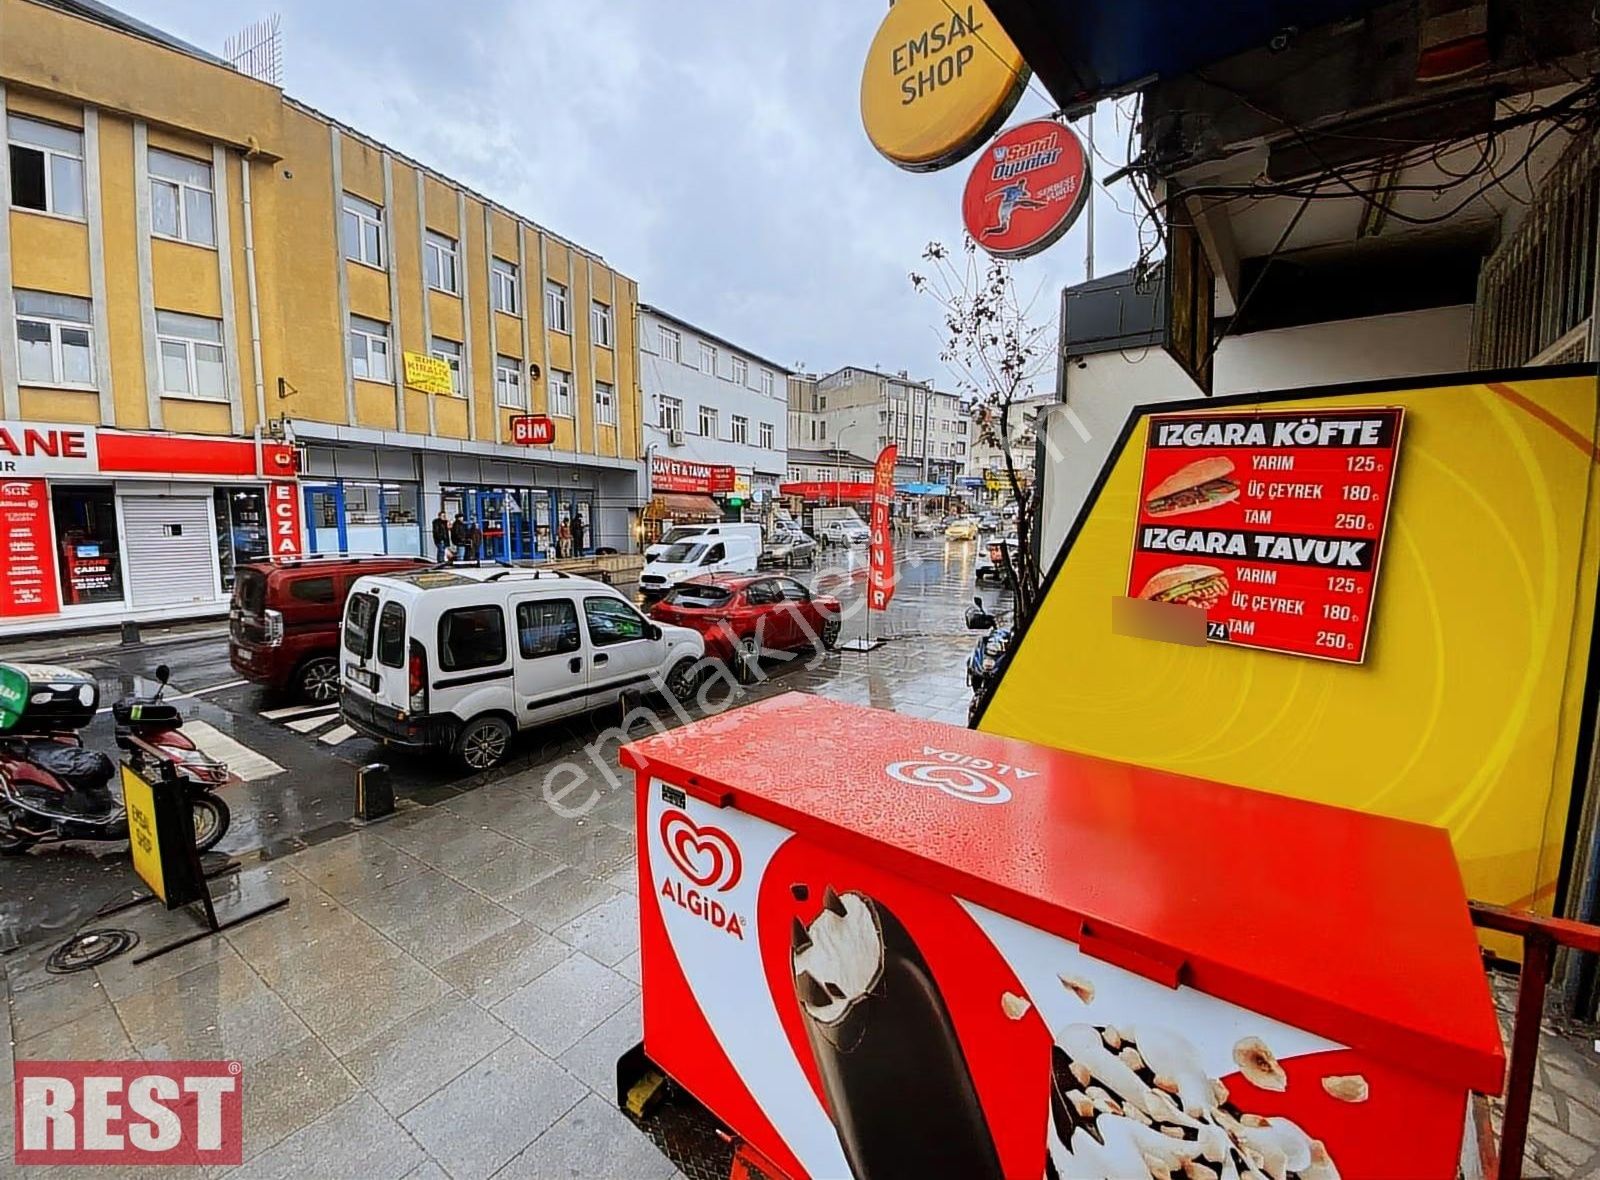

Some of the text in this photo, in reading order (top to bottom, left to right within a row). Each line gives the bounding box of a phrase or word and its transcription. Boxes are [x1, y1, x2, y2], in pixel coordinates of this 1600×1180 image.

[892, 4, 984, 76] EMSAL
[901, 44, 974, 106] SHOP
[1007, 132, 1060, 164] Sanal
[993, 147, 1062, 181] Oyunlar
[1158, 417, 1383, 446] IZGARA KÖFTE
[1252, 455, 1375, 472] YARIM 125
[1247, 480, 1371, 501] ÜÇ ÇEYREK 180
[1244, 509, 1366, 530] TAM 250
[873, 507, 884, 606] DÖNER
[1142, 528, 1366, 567] IZGARA TAVUK
[1236, 567, 1356, 593] YARIM 125
[1231, 591, 1351, 621] ÜÇ ÇEYREK 180
[1228, 618, 1346, 649] TAM 250
[136, 827, 152, 854] SHOP
